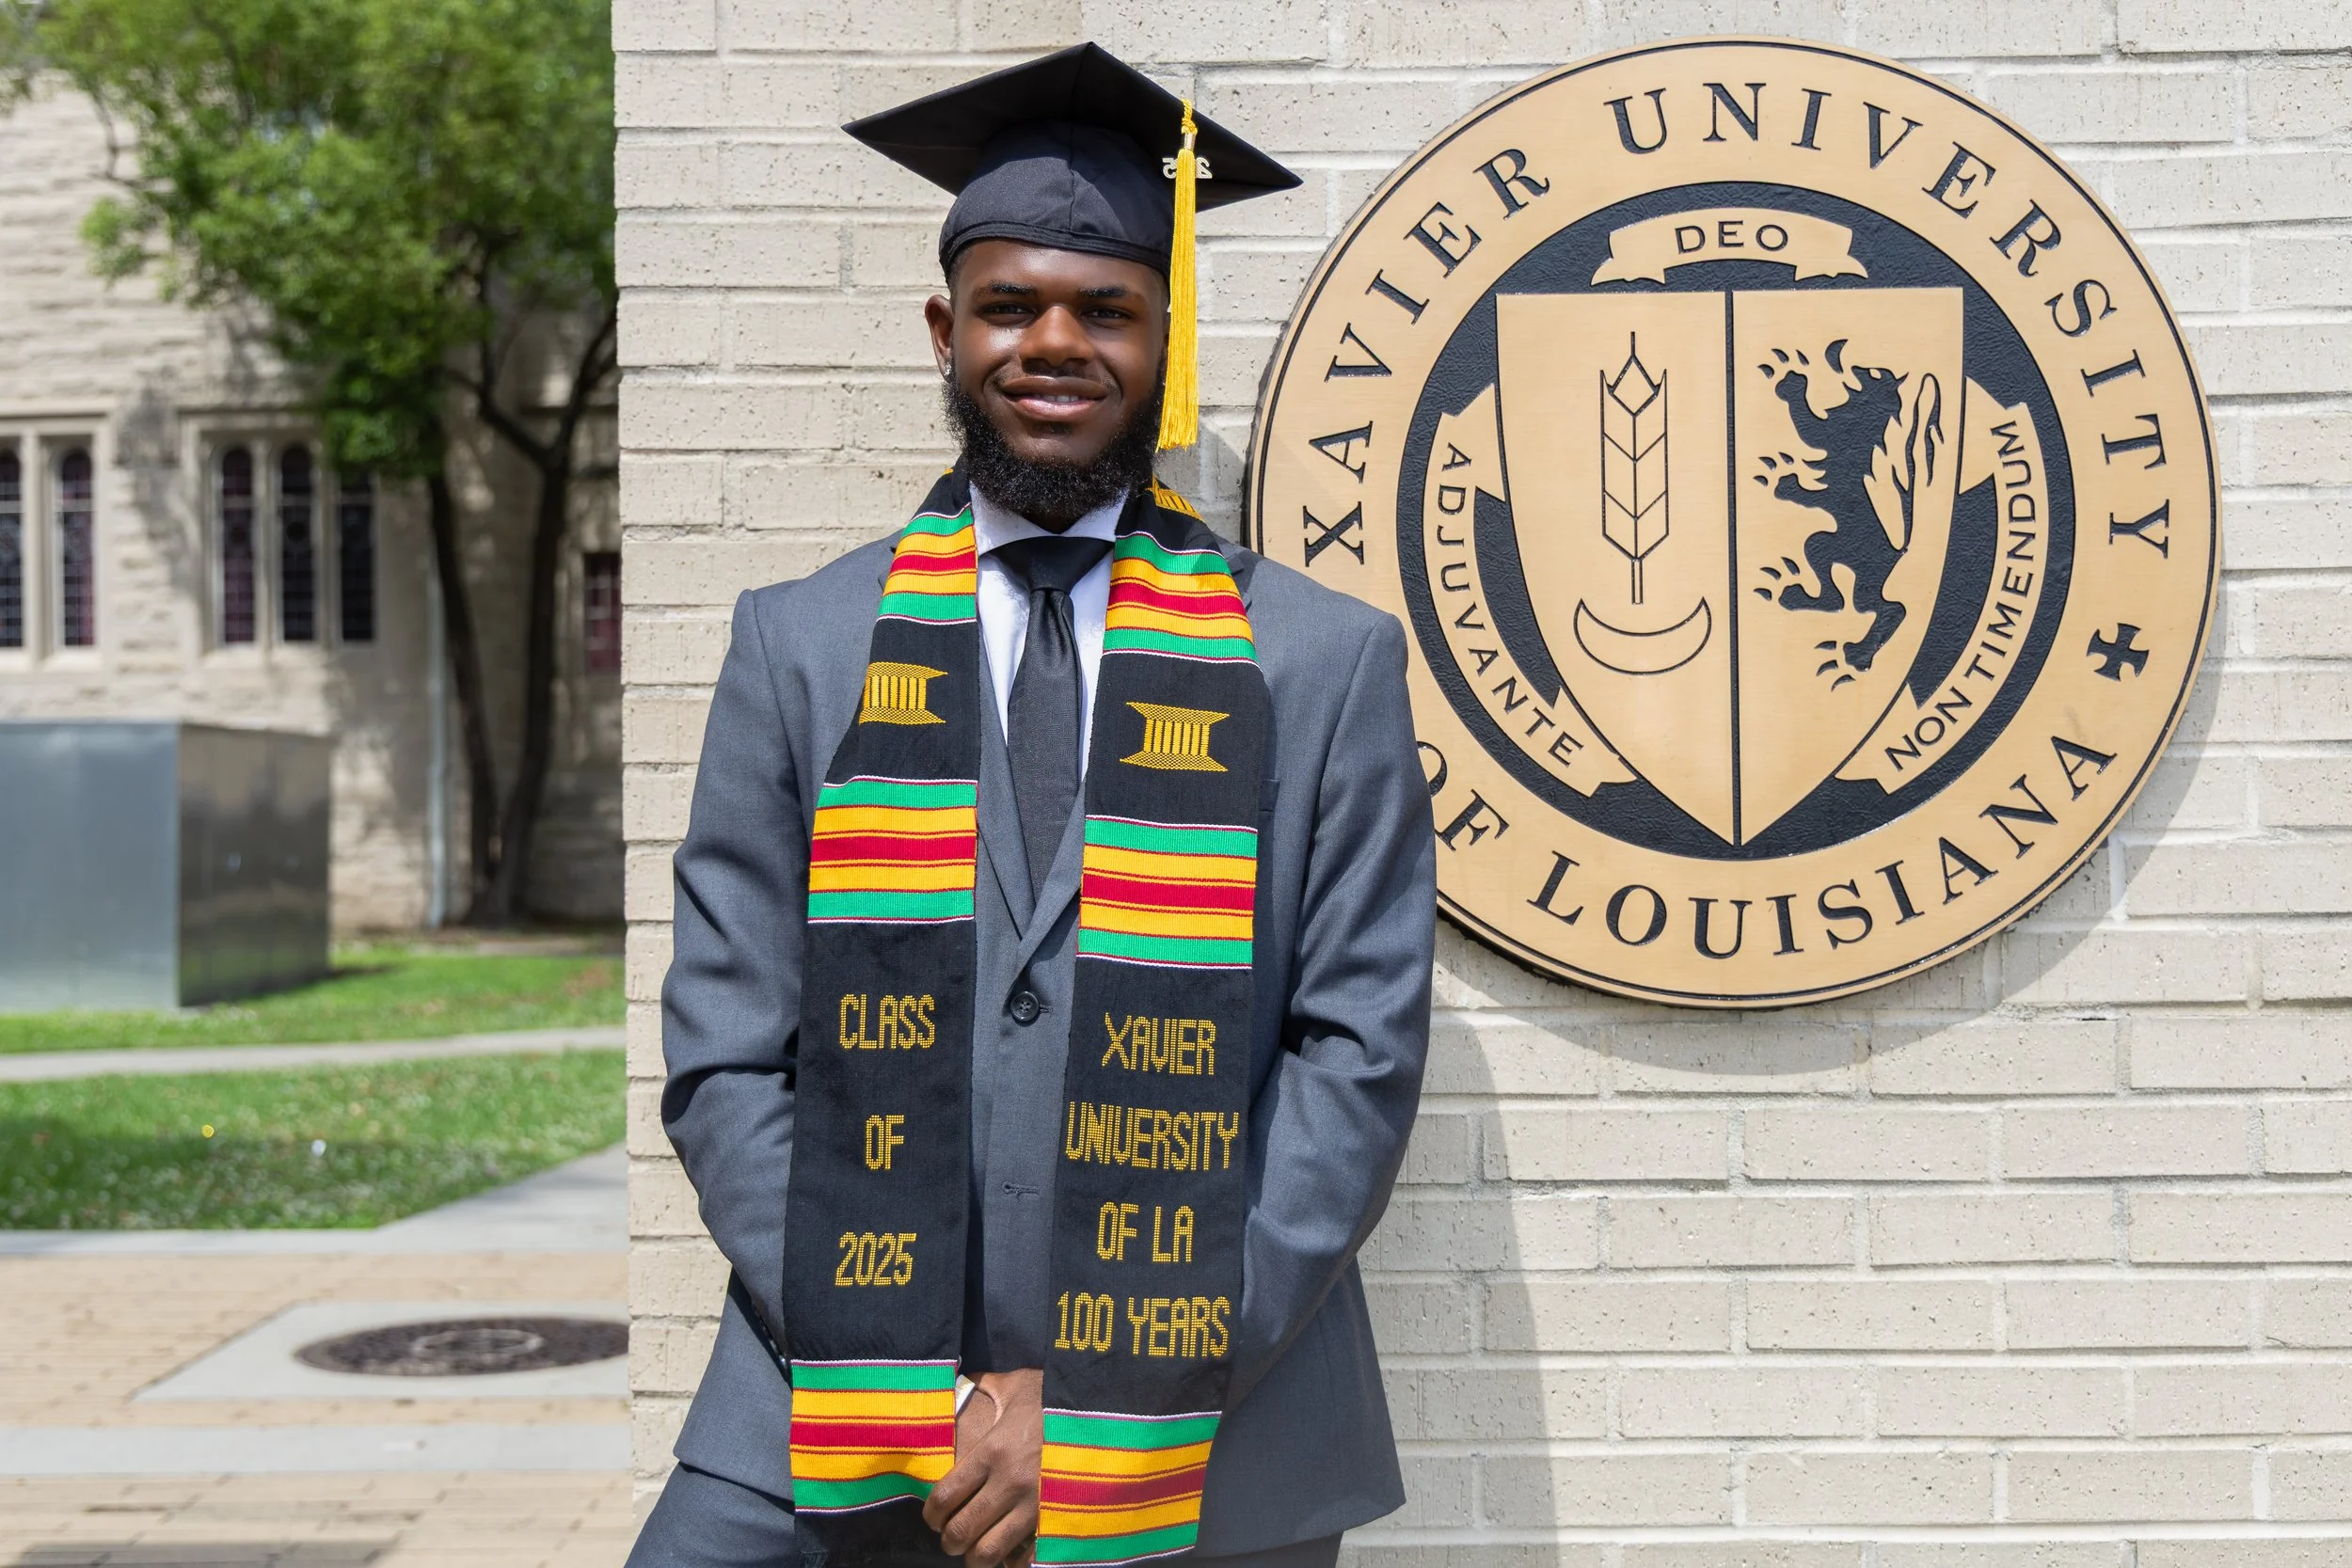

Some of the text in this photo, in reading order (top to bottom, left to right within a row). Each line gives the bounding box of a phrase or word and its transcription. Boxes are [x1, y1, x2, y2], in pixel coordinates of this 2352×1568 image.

[1675, 220, 1789, 254] DEO
[1302, 83, 2171, 568] XAVIER UNIVERSITY
[1437, 442, 1584, 768] ADJUVANTE
[1884, 420, 2037, 770] NON TIMENDUM
[1526, 736, 2118, 959] LOUISIANA
[839, 993, 935, 1050] CLASS
[1101, 1011, 1216, 1075] XAVIER
[865, 1115, 904, 1170] OF
[1065, 1101, 1239, 1171] UNIVERSITY
[834, 1231, 917, 1287] 2025
[1096, 1202, 1193, 1263] OF LA
[1055, 1292, 1231, 1358] 100 YEARS
